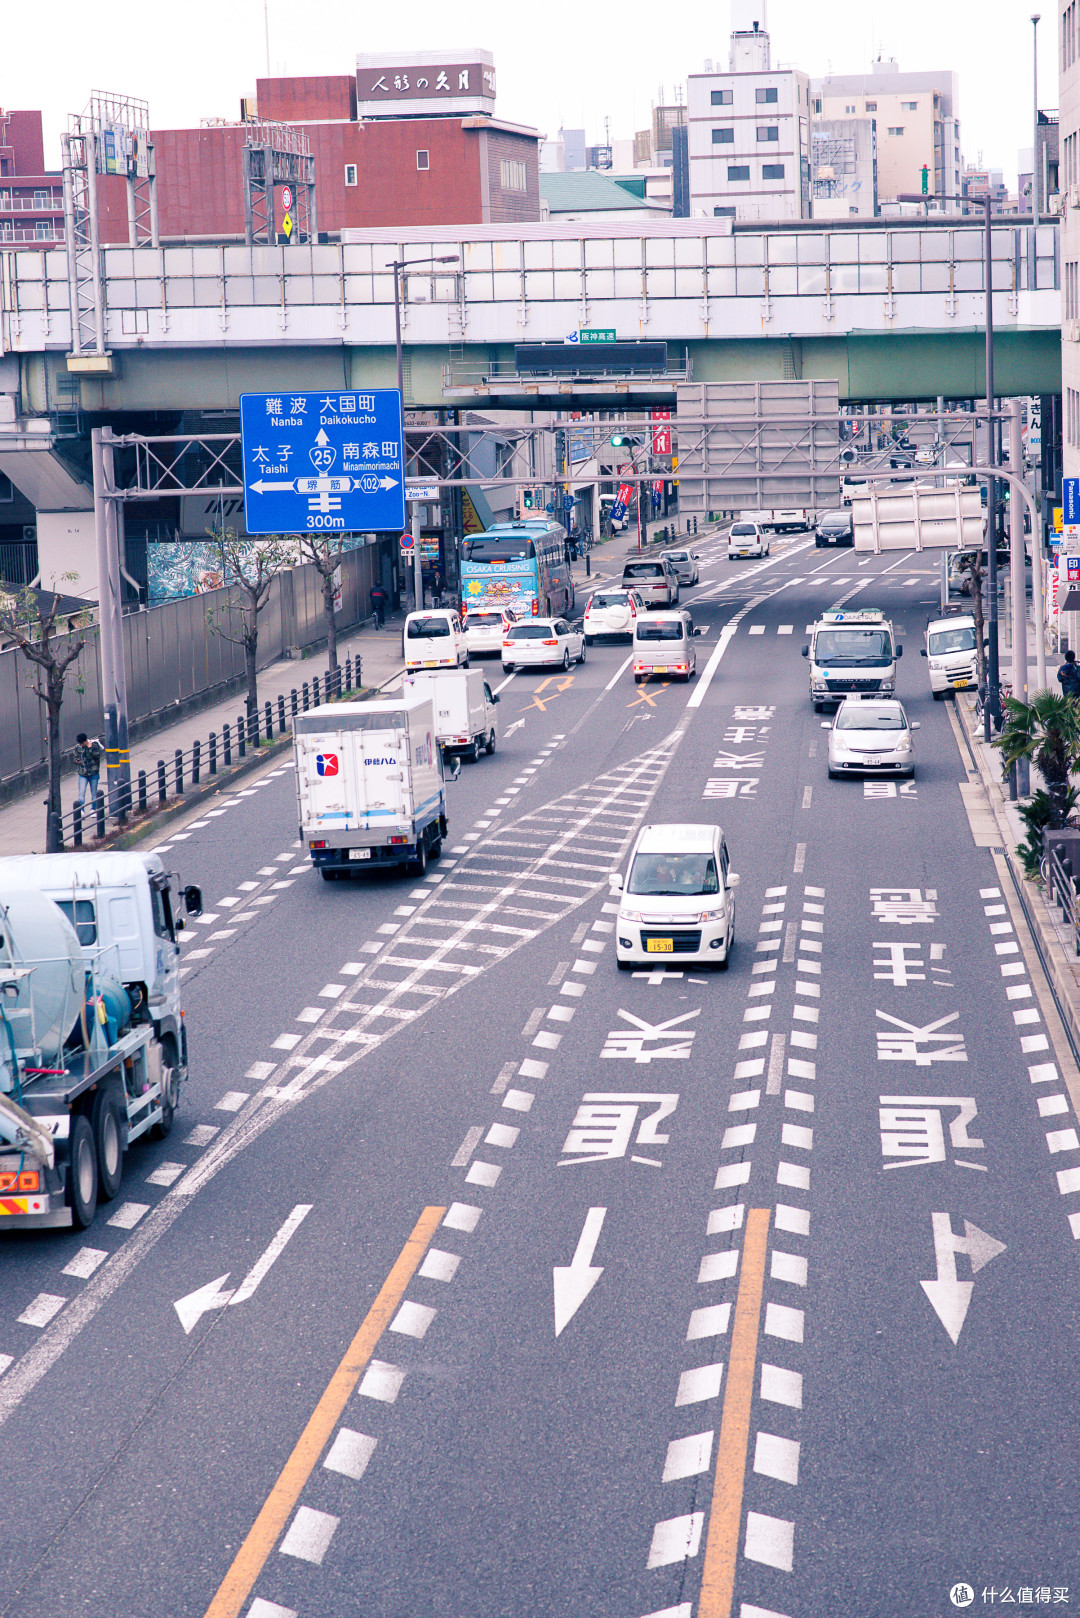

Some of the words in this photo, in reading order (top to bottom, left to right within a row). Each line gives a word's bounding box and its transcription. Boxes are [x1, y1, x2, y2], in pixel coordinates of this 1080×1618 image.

[371, 70, 469, 91] 人形の久月
[581, 332, 615, 341] 阪神高速
[265, 397, 308, 415] 難波
[319, 395, 376, 413] 大国町
[271, 417, 303, 427] Nanba
[320, 415, 377, 426] Daikokucho
[252, 445, 294, 462] 太子
[342, 441, 399, 460] 南森町
[314, 450, 332, 465] 25
[259, 463, 288, 474] Taishi
[343, 461, 400, 472] Minamimorimachi
[306, 479, 341, 491] 堺筋
[362, 477, 378, 490] 102
[1068, 480, 1076, 519] Panasonic
[306, 515, 345, 528] 300m
[466, 565, 492, 574] OSAKA
[493, 563, 530, 573] CRUISING
[870, 888, 989, 1172] 追突注意
